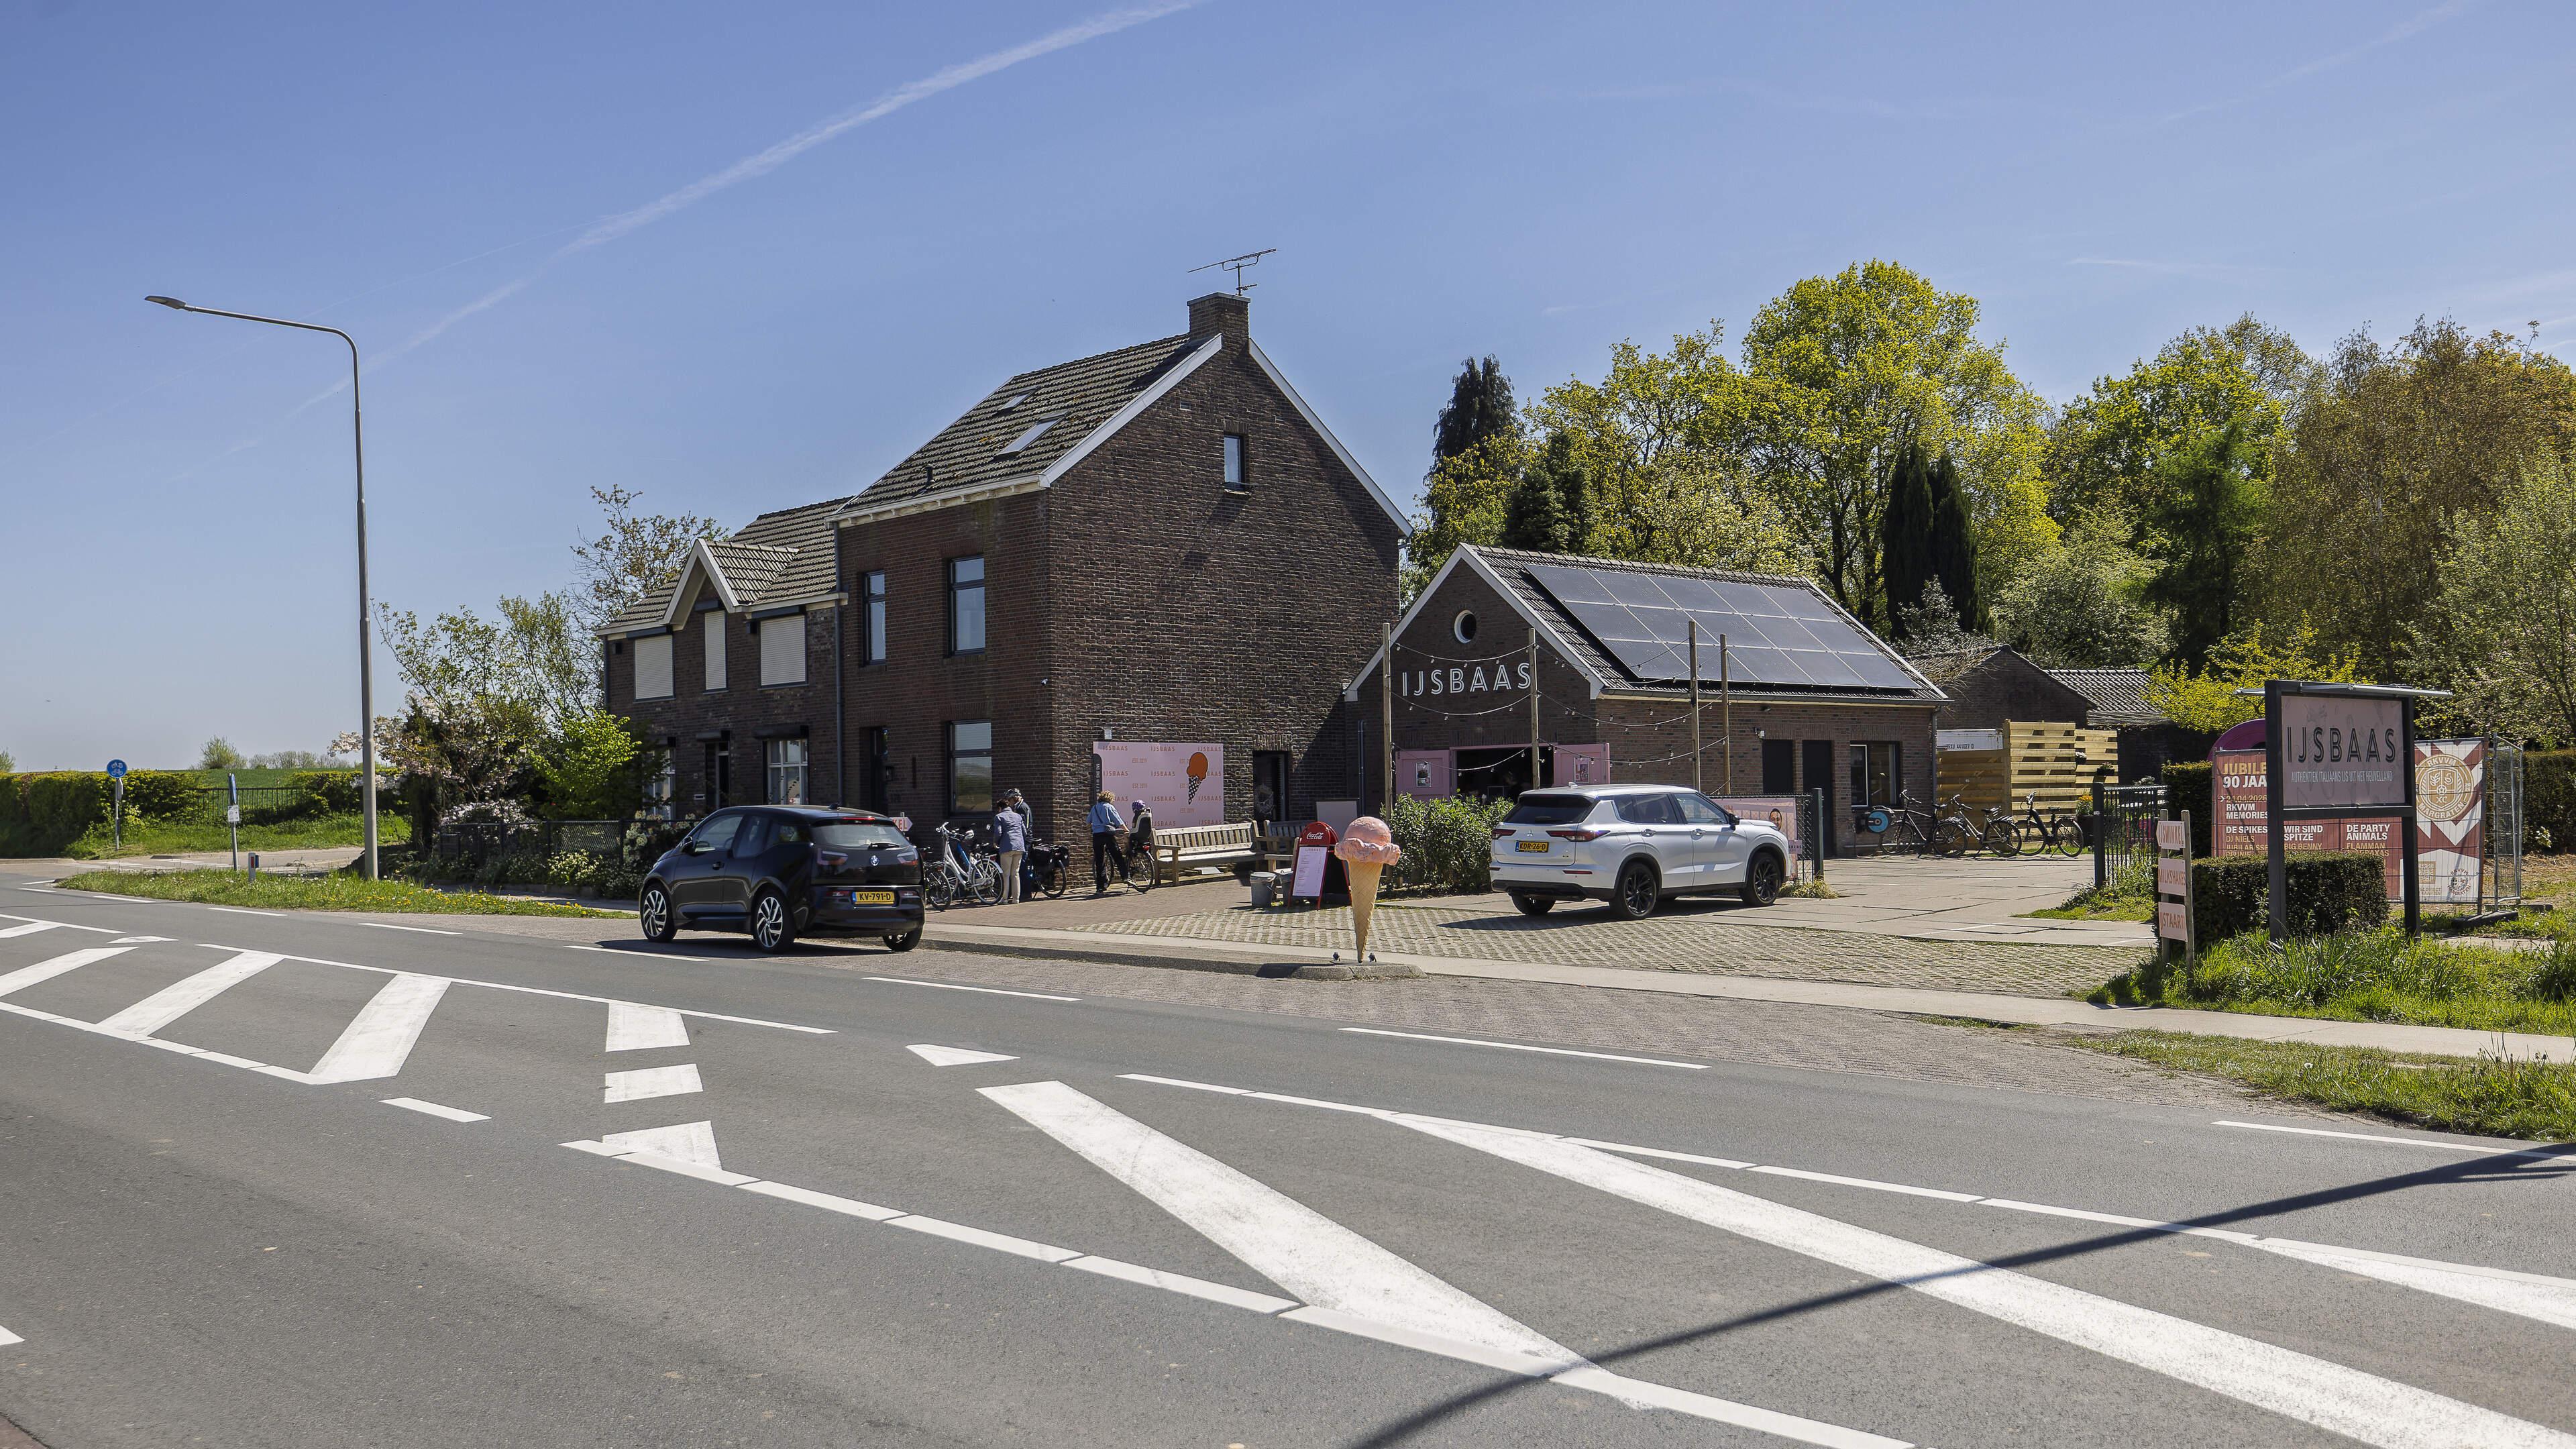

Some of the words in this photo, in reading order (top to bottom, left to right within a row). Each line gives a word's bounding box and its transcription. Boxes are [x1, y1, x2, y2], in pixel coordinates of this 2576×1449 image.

[1402, 662, 1531, 697] IJSBAAS
[2287, 727, 2396, 763] IJSBAAS
[2426, 757, 2457, 767] RKVVM
[2222, 775, 2240, 788] 90
[2357, 771, 2365, 782] HET
[2366, 771, 2393, 782] HEUVELLAND
[2226, 803, 2255, 811] RKVVM
[2418, 802, 2465, 818] MARGRATEN
[2226, 826, 2237, 834] DE
[2238, 826, 2268, 834] SPIKES
[2302, 825, 2323, 833] SIND
[2347, 824, 2359, 833] DE
[2360, 824, 2390, 833] PARTY
[2158, 825, 2184, 845] IJSWINKEL
[2284, 833, 2314, 841] SPITZE
[2346, 833, 2388, 841] ANIMALS
[2158, 869, 2186, 886] MILKSHAKES
[859, 893, 892, 901] KV-791-D
